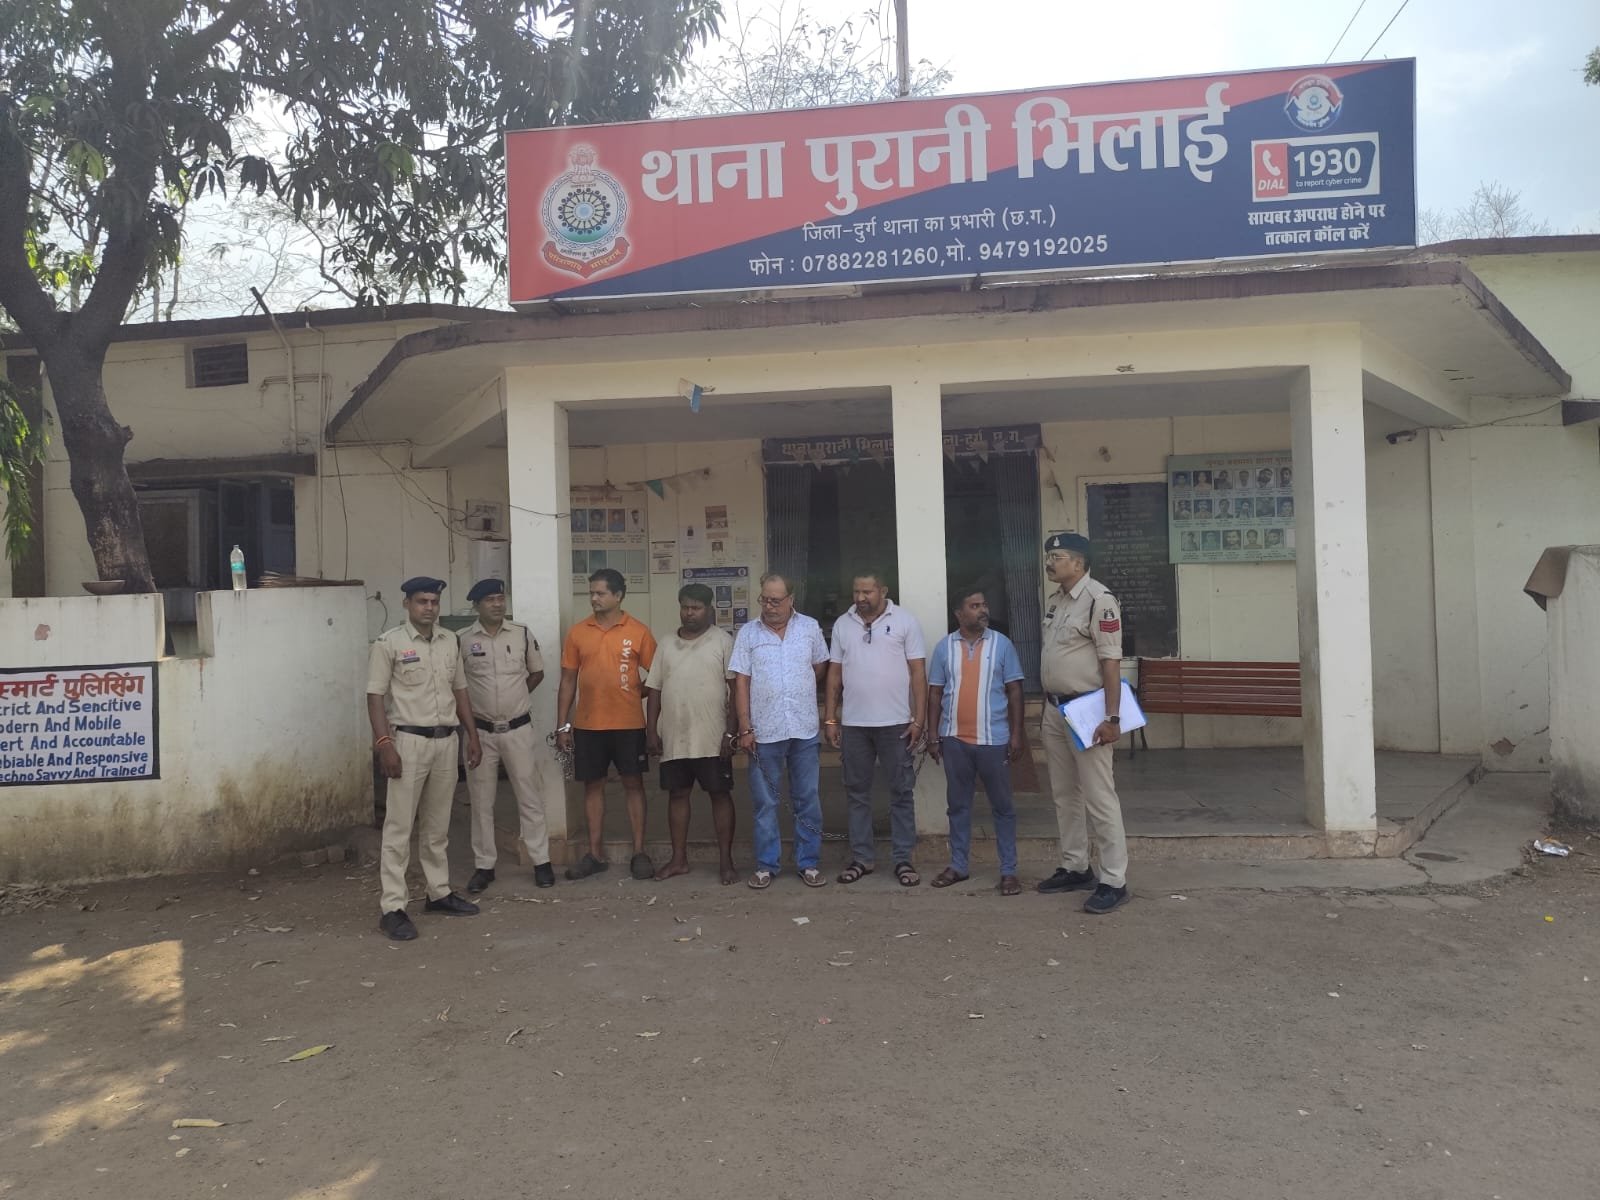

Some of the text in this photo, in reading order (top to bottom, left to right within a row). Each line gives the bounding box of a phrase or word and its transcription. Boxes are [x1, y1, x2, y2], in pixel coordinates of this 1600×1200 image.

[641, 81, 1231, 216] थाना पुरानी भिलाई
[1294, 147, 1362, 177] 1930
[1258, 178, 1286, 191] DIAL
[1304, 179, 1325, 188] report
[1325, 178, 1343, 187] cyber
[1344, 177, 1362, 185] crime
[883, 218, 918, 236] थाना
[924, 216, 945, 233] का
[950, 207, 995, 231] प्रभारी
[1247, 202, 1387, 225] सायबर अपराध होने पर
[1313, 225, 1347, 242] कॉल
[1348, 223, 1371, 241] करें
[749, 250, 783, 276] फोन
[979, 234, 1108, 262] 9479192025
[619, 638, 633, 693] SWIGGY
[63, 671, 146, 700] पुलिसिंग
[36, 700, 65, 714] And
[68, 698, 142, 714] Sencitive
[44, 717, 71, 732] And
[74, 715, 122, 731] Mobile
[30, 735, 57, 750] And
[63, 732, 146, 748] Accountable
[47, 752, 73, 767] And
[75, 751, 148, 768] Responsive
[73, 767, 96, 779] And
[100, 764, 146, 778] Trained
